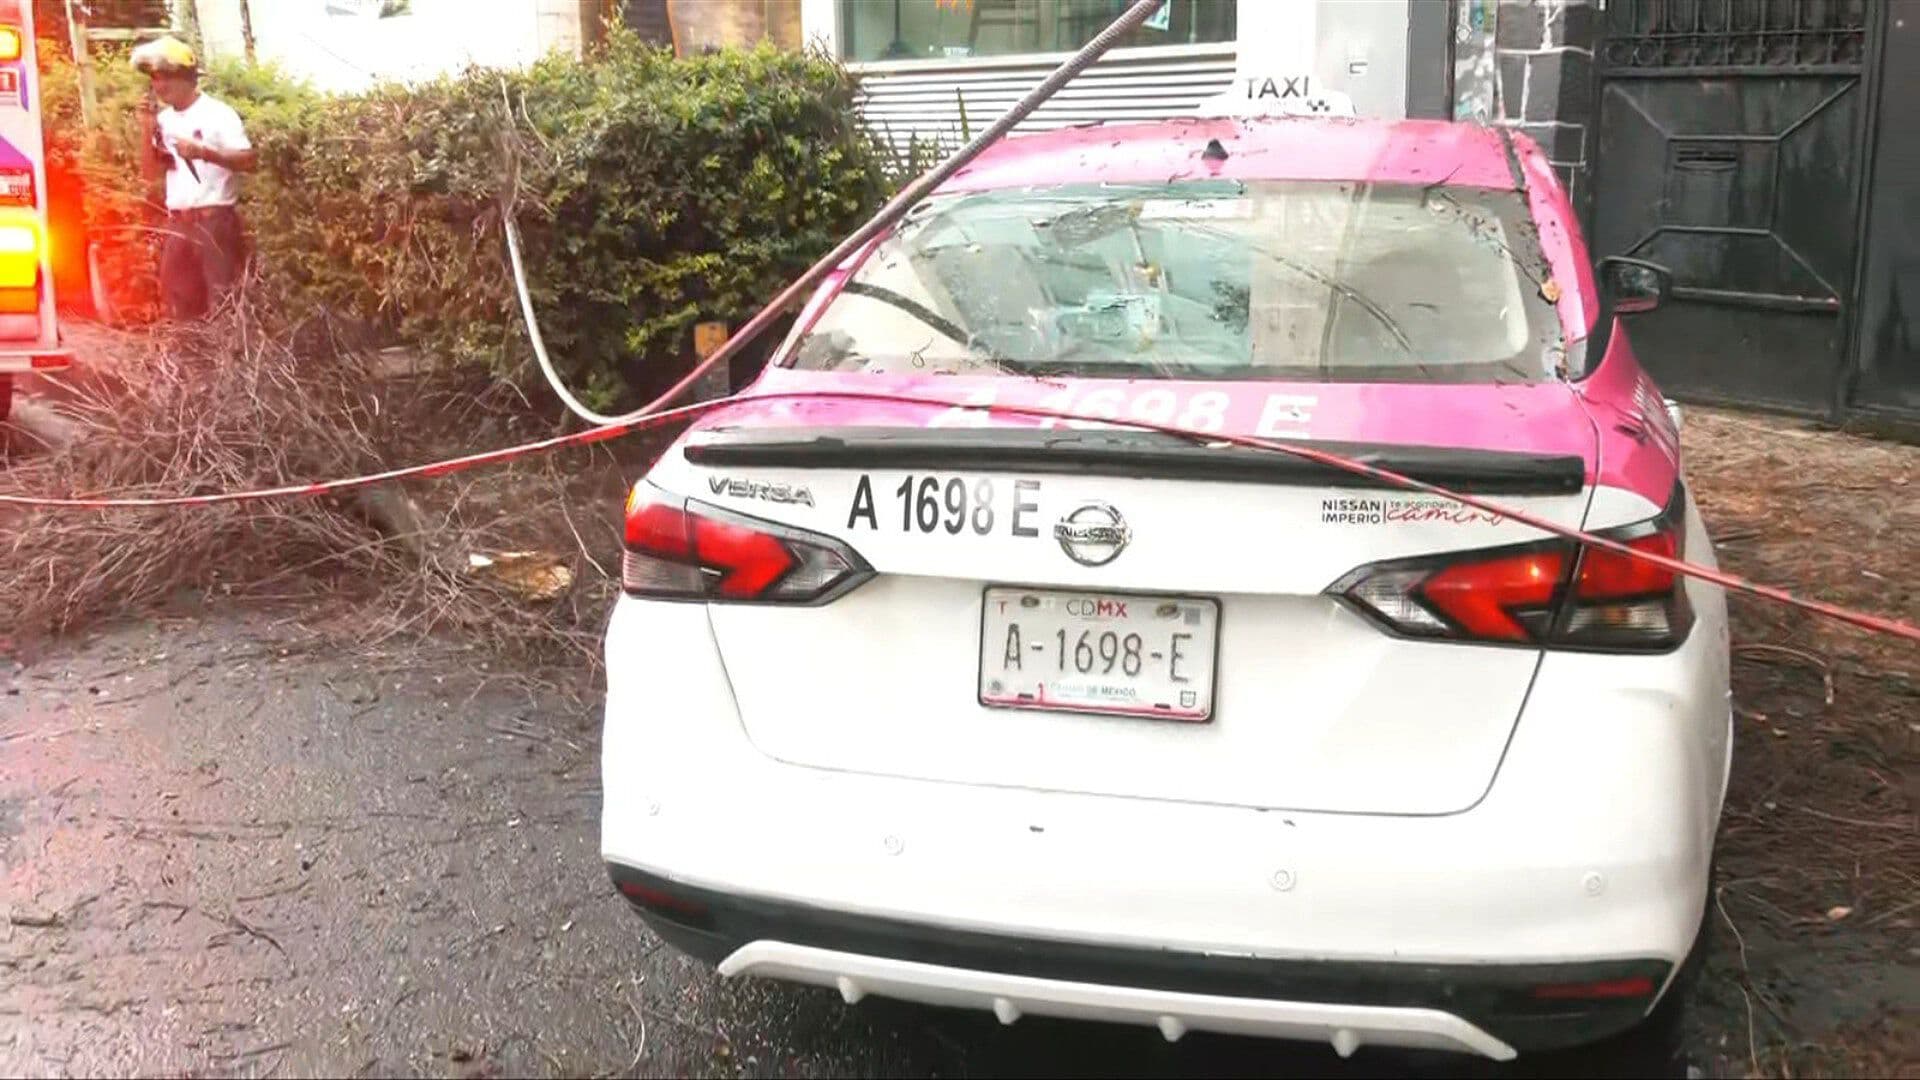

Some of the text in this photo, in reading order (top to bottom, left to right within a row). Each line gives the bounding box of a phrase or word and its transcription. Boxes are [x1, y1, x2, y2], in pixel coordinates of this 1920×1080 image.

[1245, 75, 1309, 99] TAXI
[1255, 395, 1318, 439] E
[708, 475, 816, 508] VERSA
[847, 474, 1041, 538] A 1698 E
[1322, 500, 1380, 512] NISSAN
[1322, 513, 1381, 525] IMPERIO
[1066, 599, 1128, 619] CDMX
[1003, 622, 1193, 683] A-1698-E
